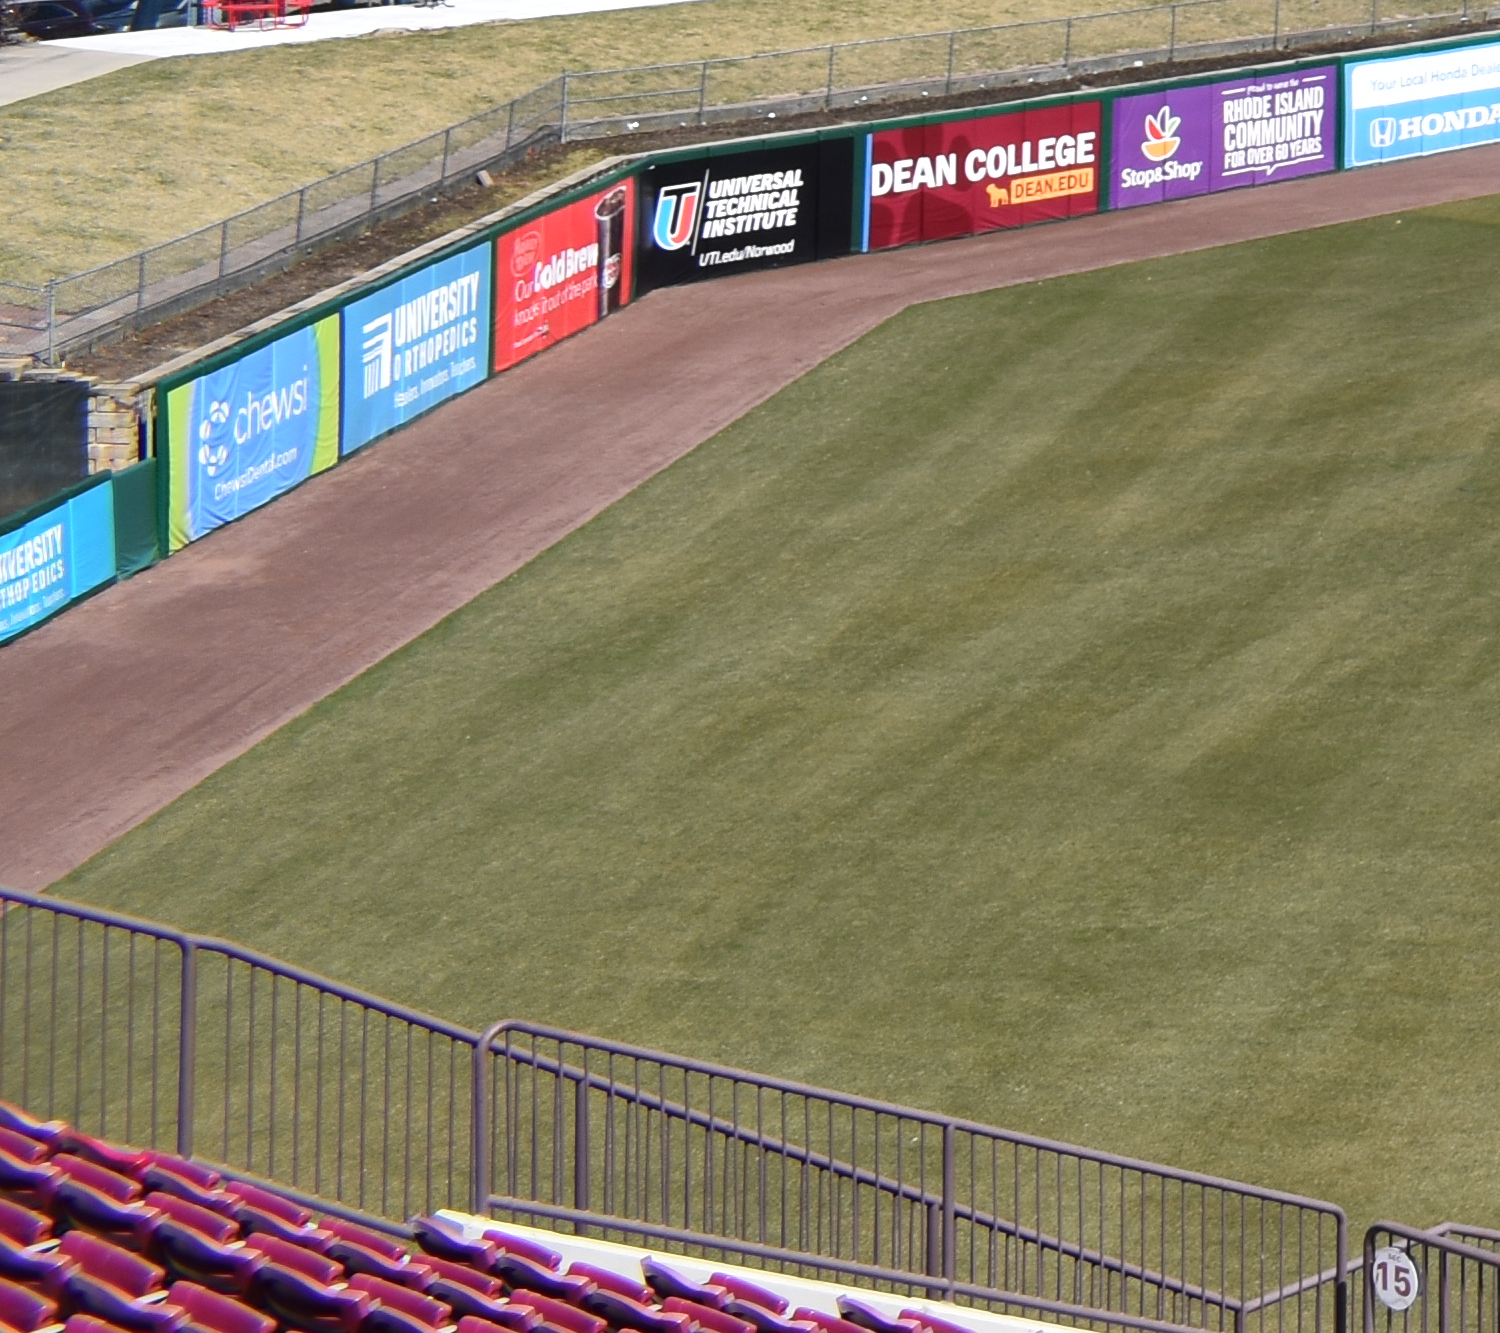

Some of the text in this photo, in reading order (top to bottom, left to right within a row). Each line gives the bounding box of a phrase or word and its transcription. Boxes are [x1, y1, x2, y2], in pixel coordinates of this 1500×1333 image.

[1371, 79, 1397, 91] Your
[1400, 73, 1427, 87] Local
[1431, 68, 1468, 82] Honda
[1223, 86, 1324, 123] RHODE ISLAND
[1224, 109, 1324, 151] COMMUNITY
[872, 131, 1097, 197] DEAN COLLEGE
[1225, 137, 1322, 169] FOR OVER 60 YEARS
[709, 169, 804, 200] UNIVERSAL
[1015, 171, 1089, 200] DEAN.EDU
[706, 191, 800, 219] TECHNICAL
[702, 208, 798, 239] INSTITUTE
[395, 271, 479, 347] UNIVERSITY
[395, 317, 477, 381] ORTHOPEDICS
[234, 364, 308, 445] chewsi
[214, 447, 297, 501] ChewsiDental.com
[1377, 1262, 1411, 1297] 15
